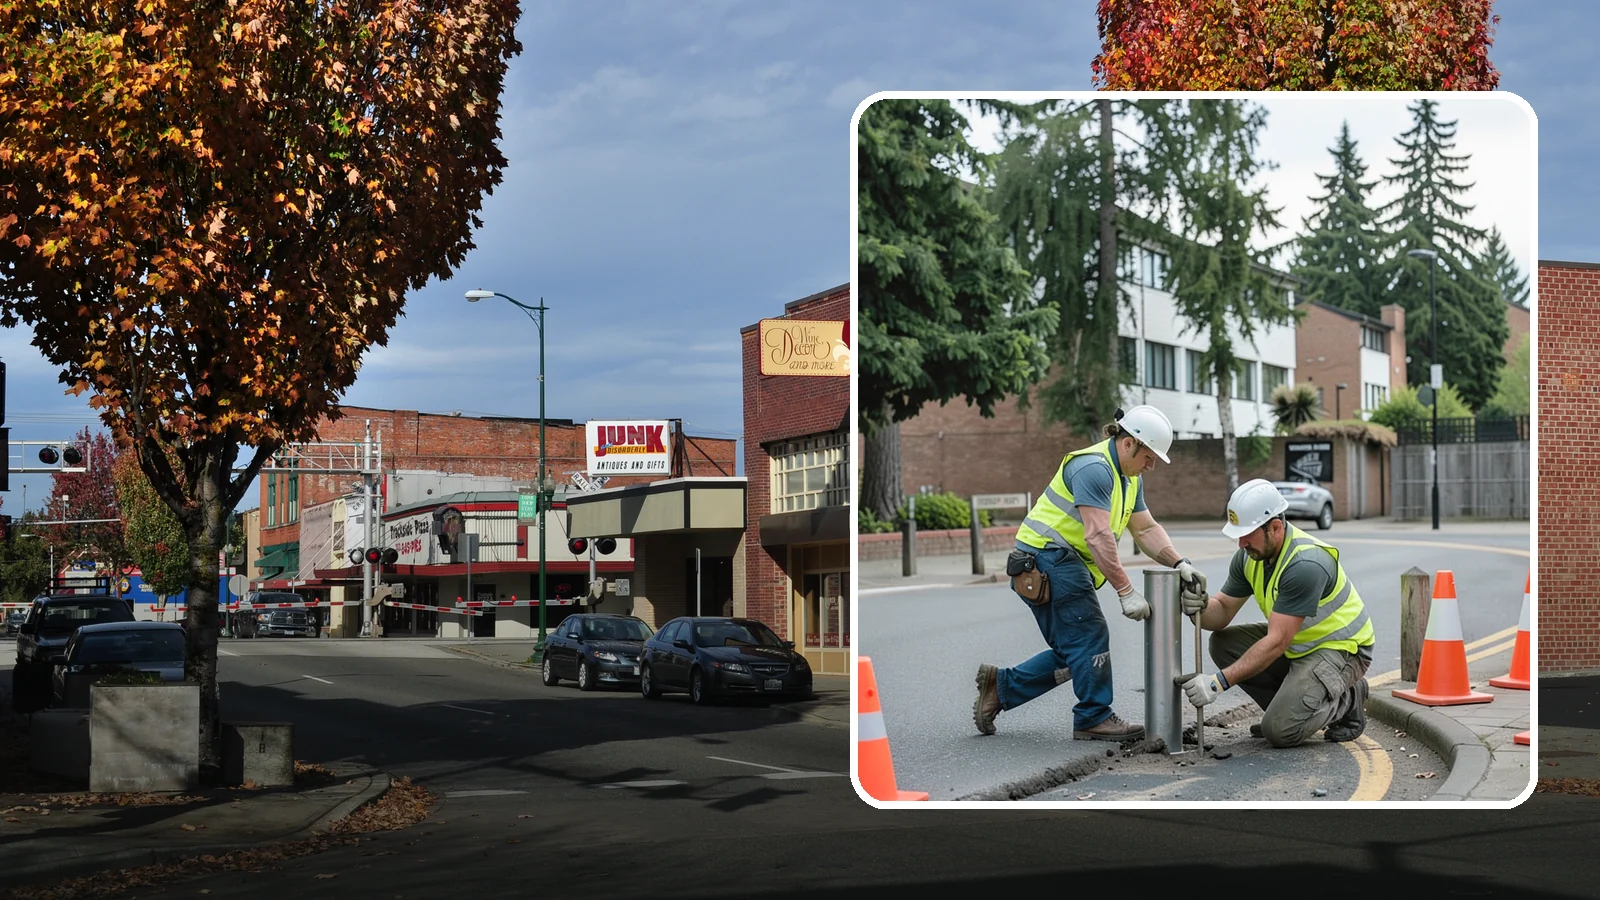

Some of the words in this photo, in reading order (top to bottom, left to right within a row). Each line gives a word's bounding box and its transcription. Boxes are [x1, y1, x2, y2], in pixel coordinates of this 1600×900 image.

[595, 425, 666, 457] JUNK
[597, 461, 628, 470] ANTIQUES
[631, 461, 643, 469] AND
[647, 460, 665, 469] GIFTS
[573, 473, 588, 490] RAIL
[414, 519, 429, 534] Pizza
